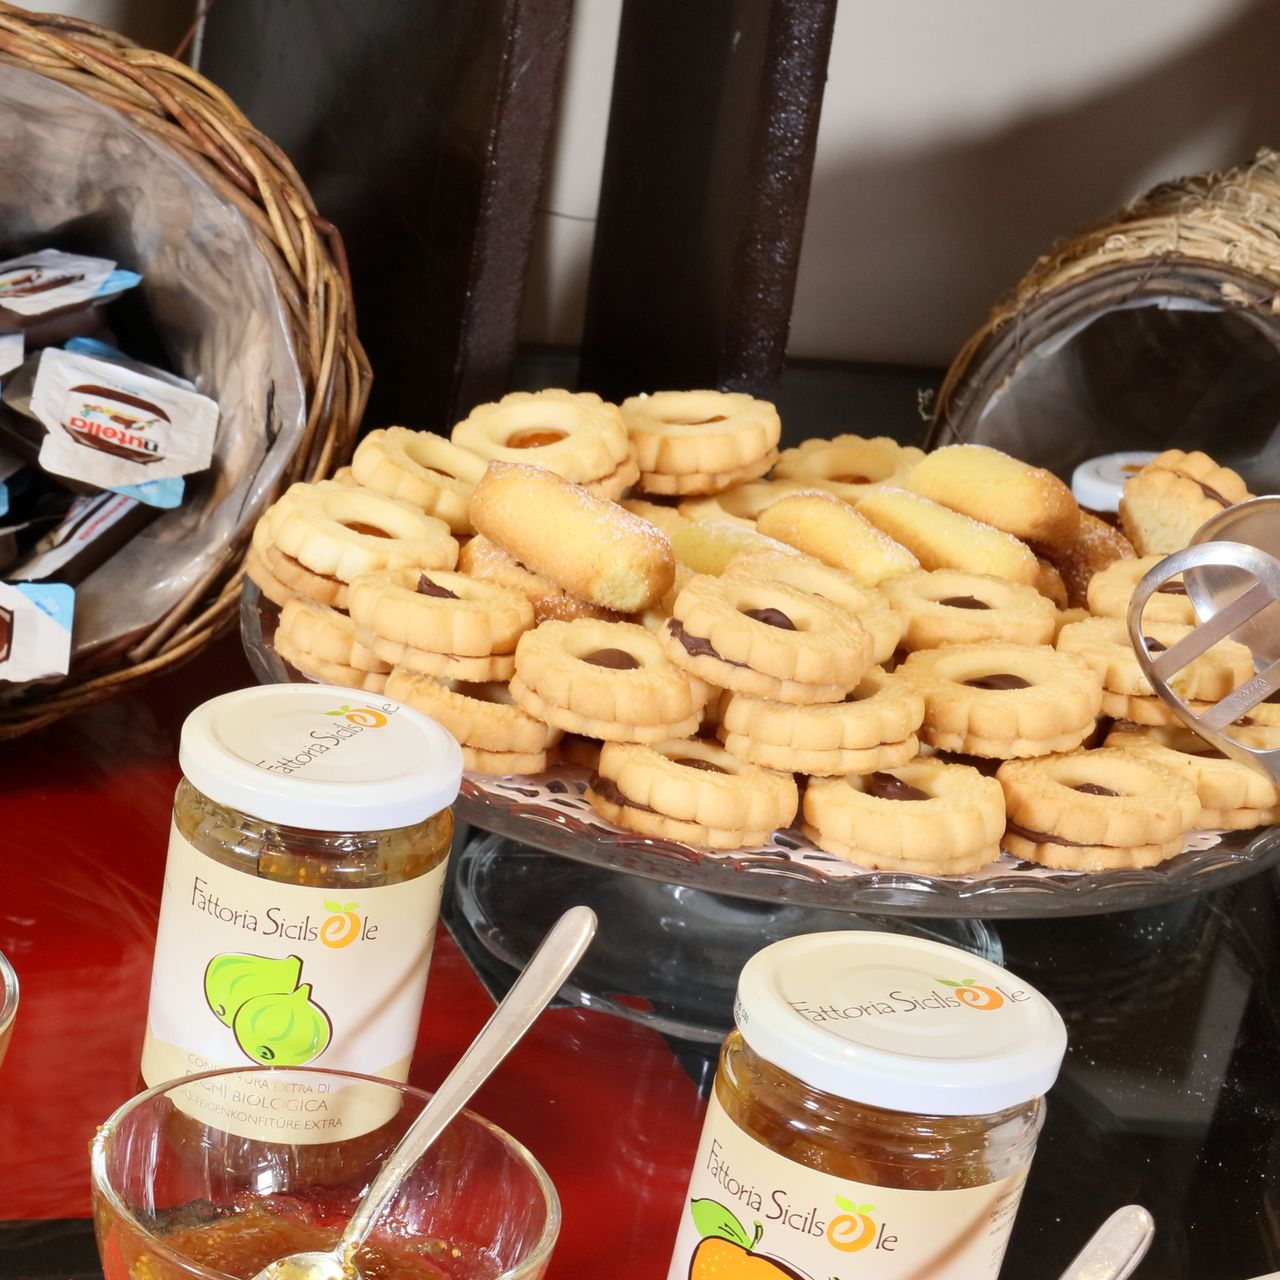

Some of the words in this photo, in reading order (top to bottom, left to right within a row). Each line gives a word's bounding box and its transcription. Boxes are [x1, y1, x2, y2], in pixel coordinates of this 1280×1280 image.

[69, 416, 159, 452] nutella
[191, 876, 258, 932] Fattoria
[788, 1000, 896, 1022] Fattoria
[304, 1116, 343, 1131] EXTRA
[706, 1138, 763, 1212] Fattoria
